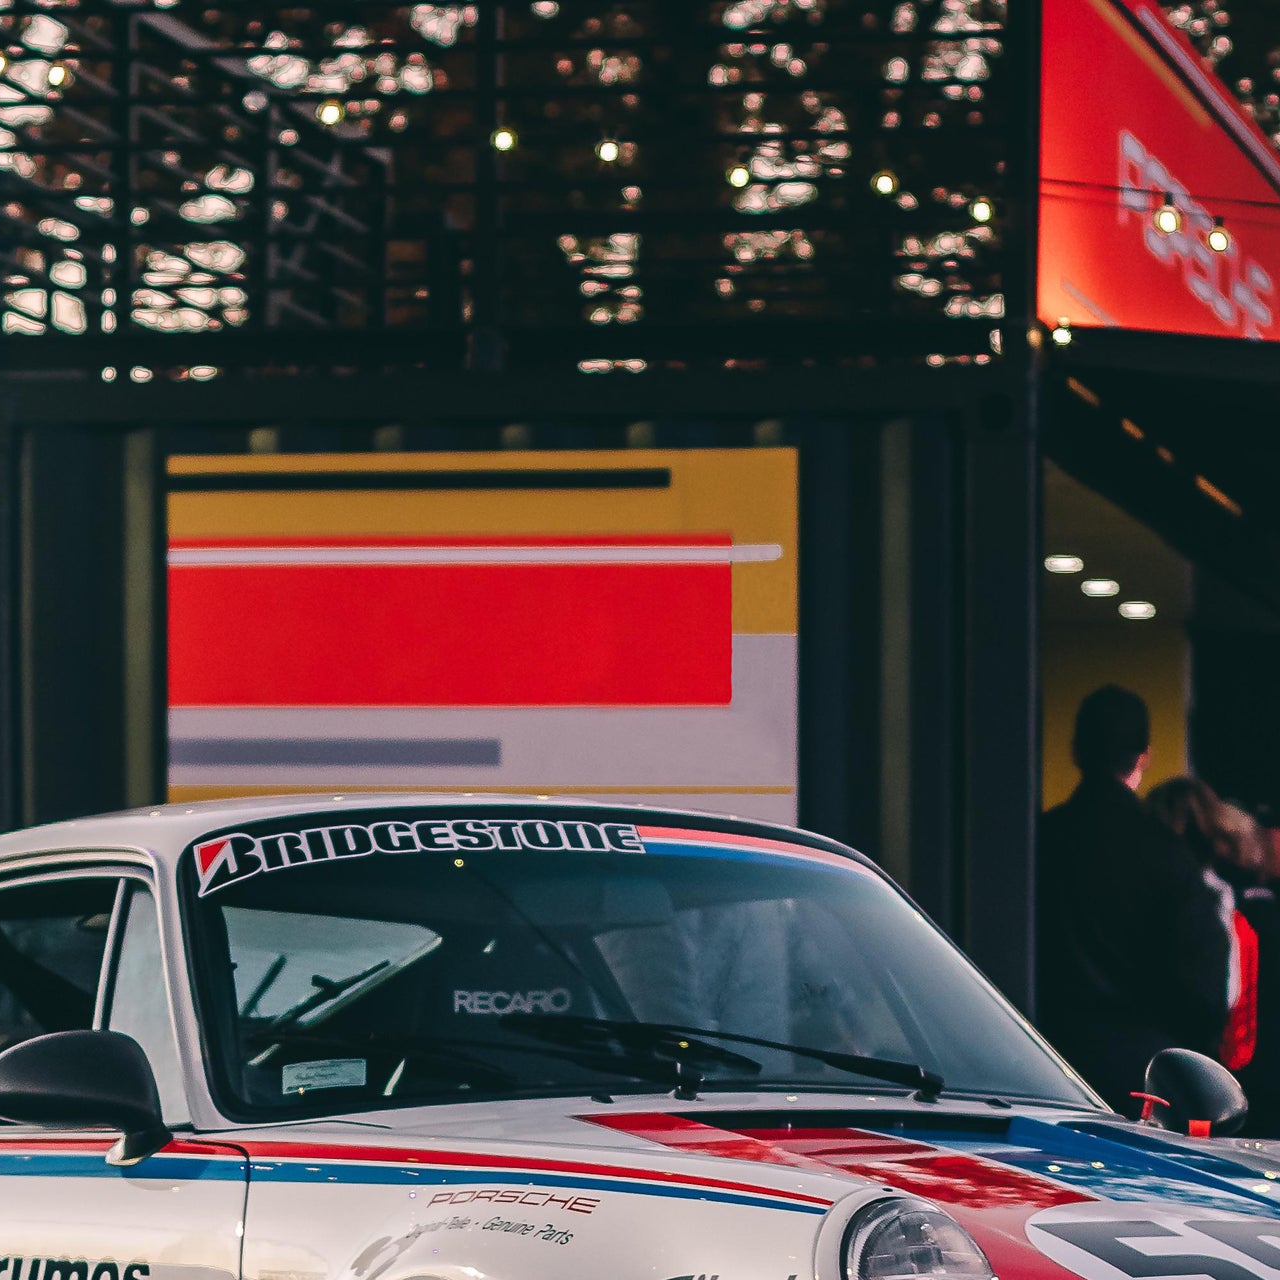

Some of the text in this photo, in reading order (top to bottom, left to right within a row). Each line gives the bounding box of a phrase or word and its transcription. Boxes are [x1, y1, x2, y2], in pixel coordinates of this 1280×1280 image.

[453, 988, 572, 1015] RECARO
[427, 1190, 601, 1214] PORSCHE
[482, 1216, 535, 1236] Genuine
[533, 1223, 575, 1246] Parts
